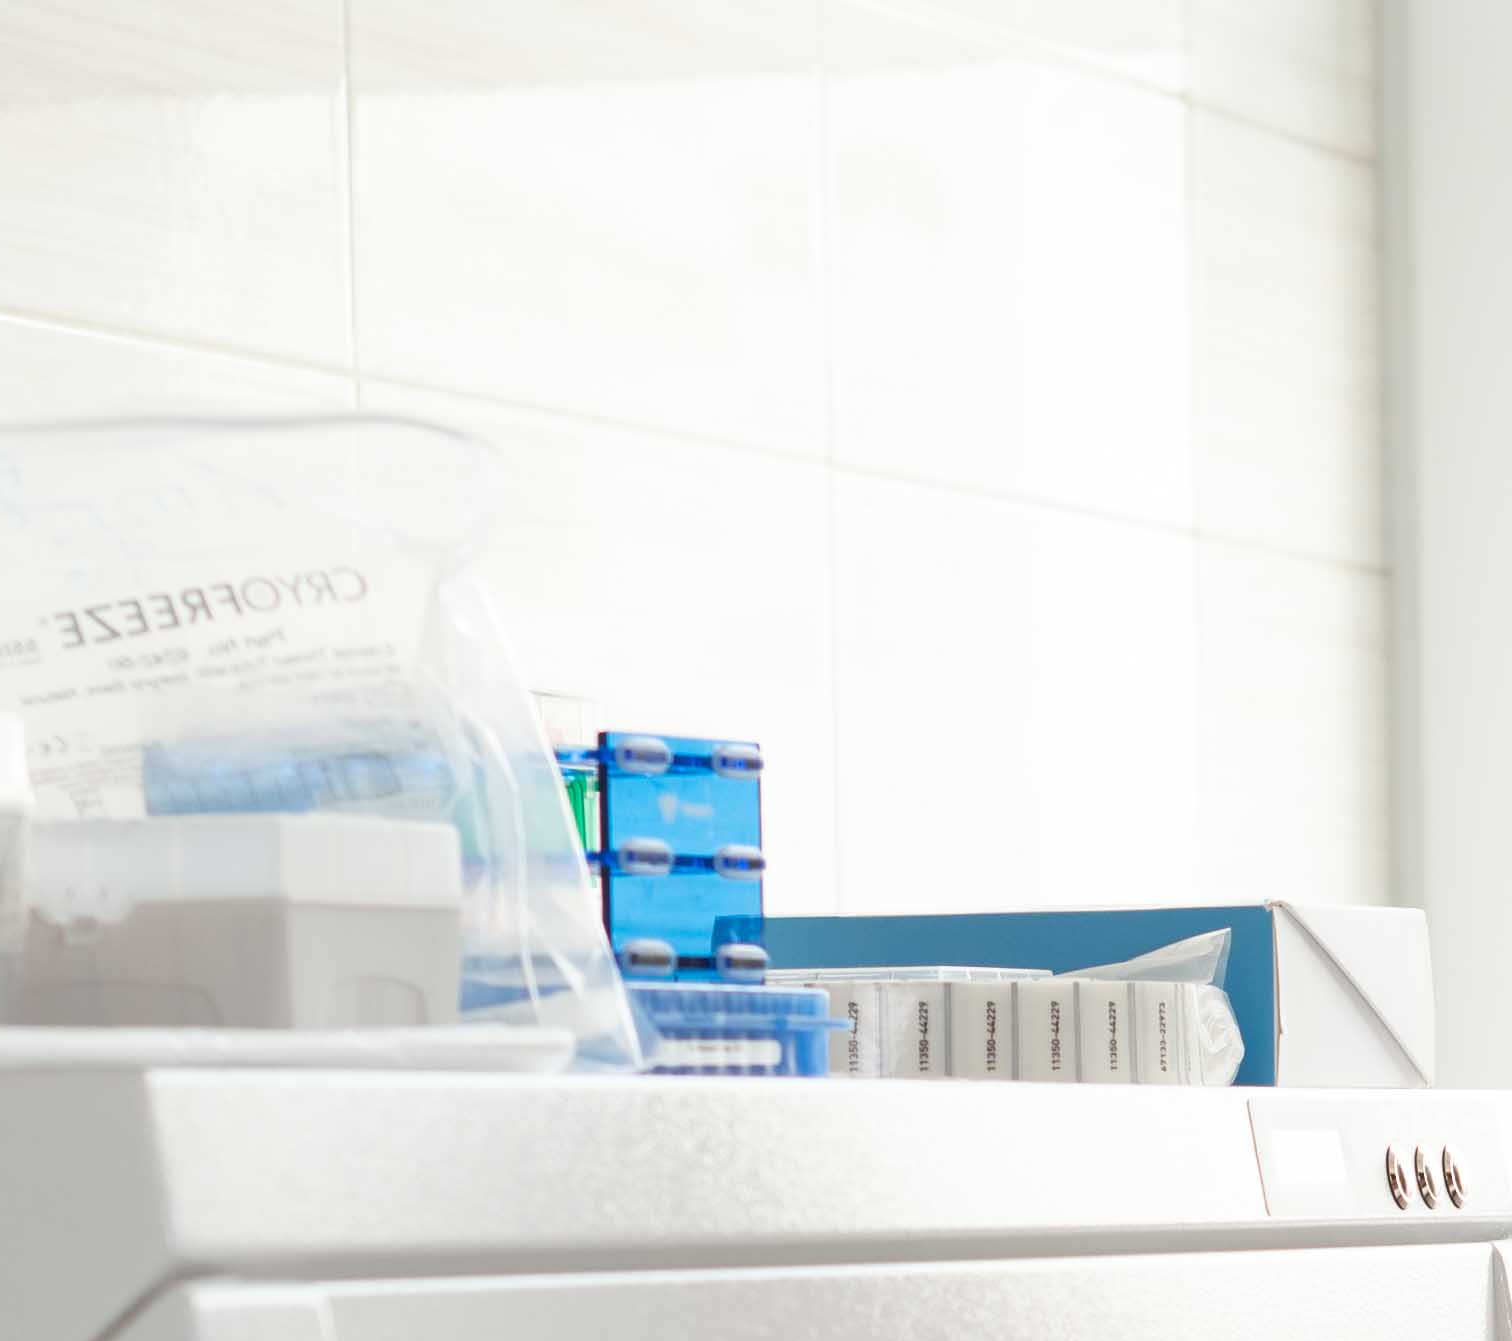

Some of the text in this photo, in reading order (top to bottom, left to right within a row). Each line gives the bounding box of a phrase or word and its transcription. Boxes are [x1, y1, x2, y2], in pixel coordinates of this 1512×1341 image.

[918, 1001, 929, 1071] 11350-44229
[986, 1000, 997, 1071] 11350-44229
[1050, 1000, 1061, 1071] 11350-44229
[1108, 1001, 1118, 1070] 11350-44229
